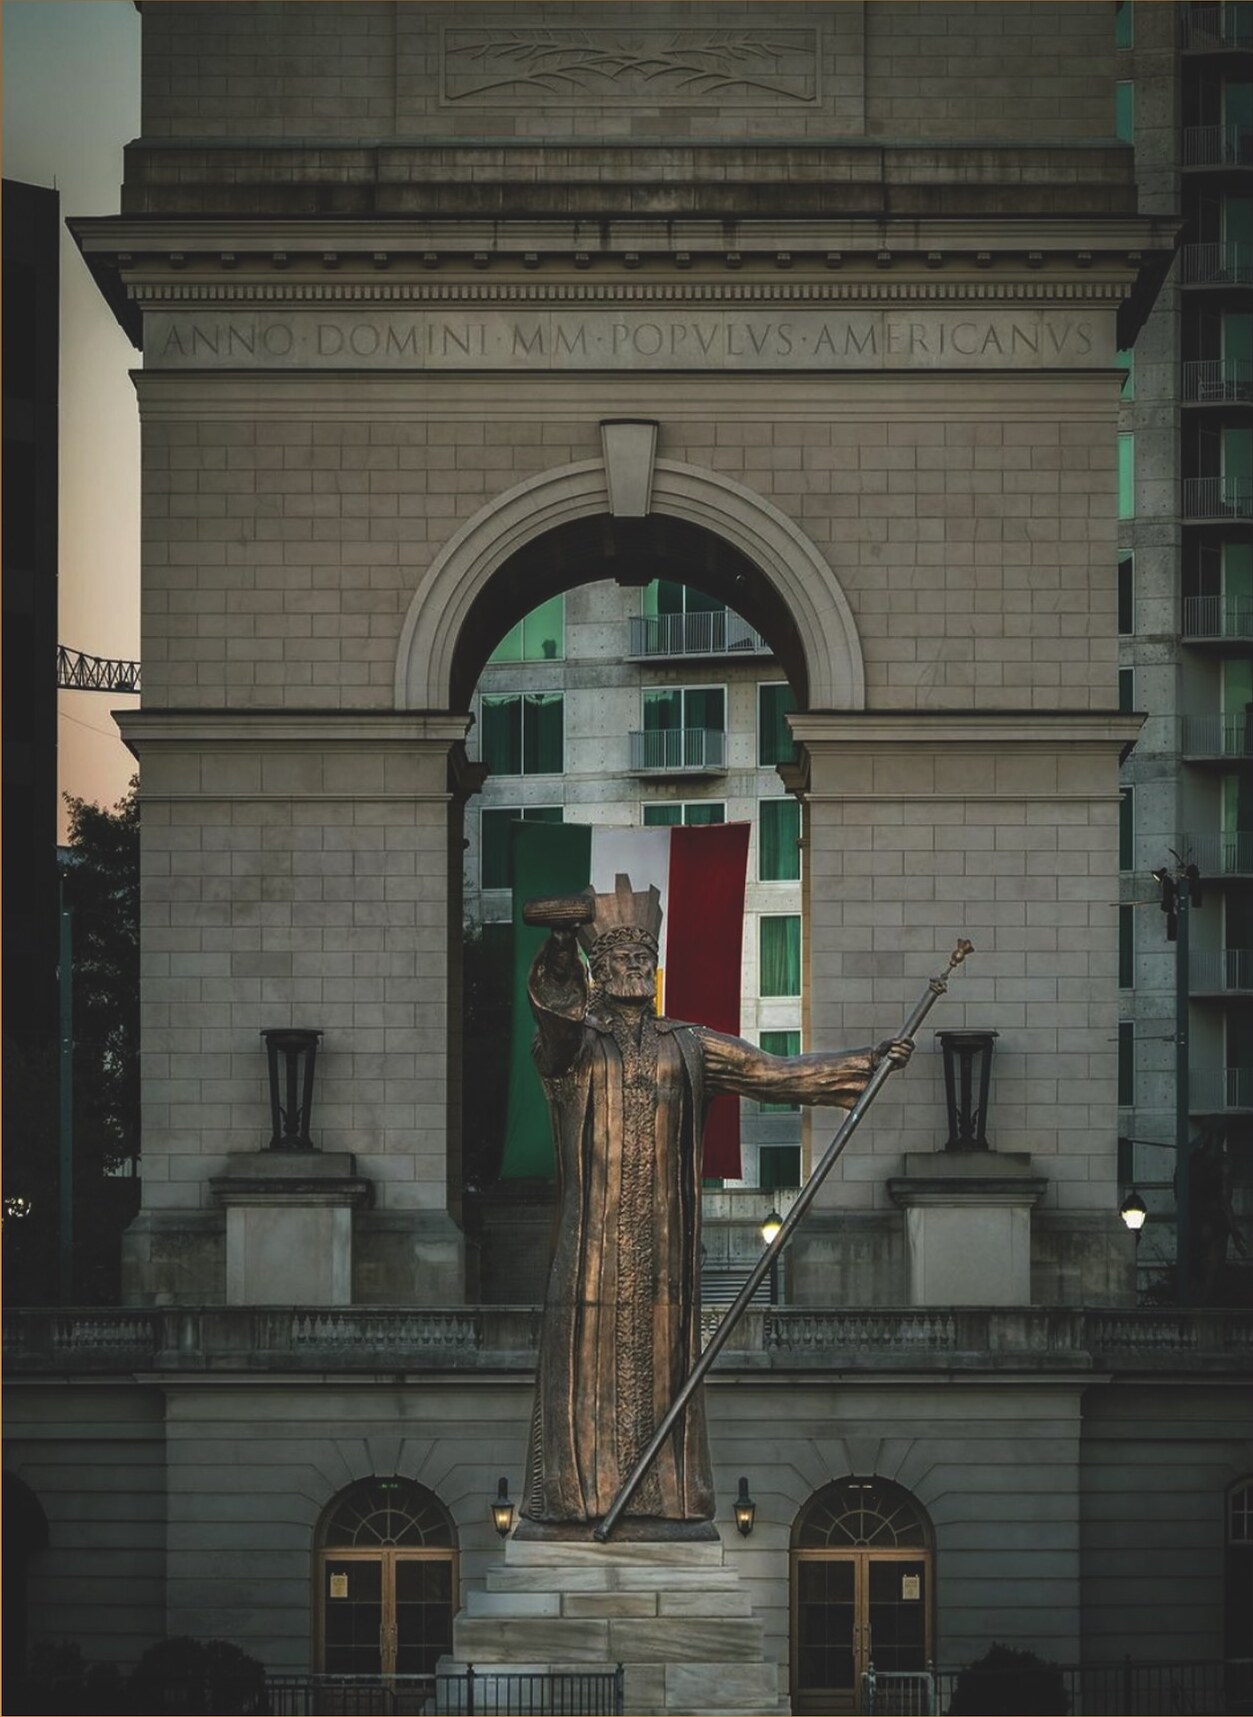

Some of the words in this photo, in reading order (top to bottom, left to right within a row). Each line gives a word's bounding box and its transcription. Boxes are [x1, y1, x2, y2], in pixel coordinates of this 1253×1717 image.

[161, 324, 294, 356] ANNO
[316, 323, 488, 356] DOMINI
[511, 323, 588, 355] MM
[611, 323, 793, 356] POPVLVS
[812, 322, 1093, 356] AMERICANVS
